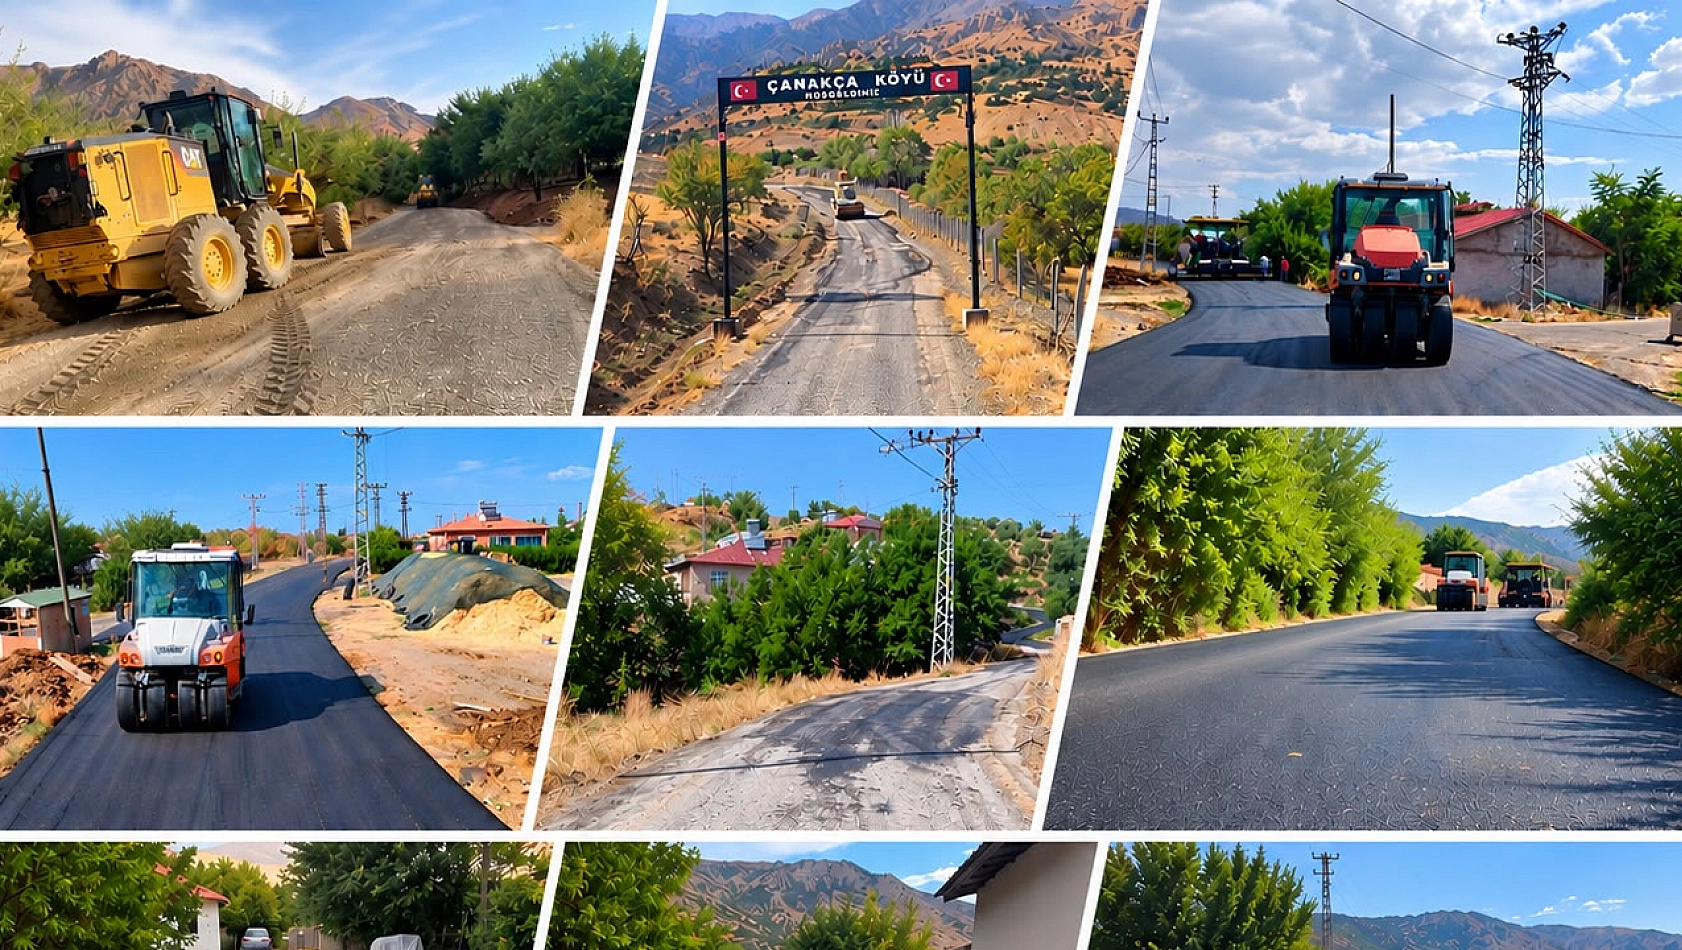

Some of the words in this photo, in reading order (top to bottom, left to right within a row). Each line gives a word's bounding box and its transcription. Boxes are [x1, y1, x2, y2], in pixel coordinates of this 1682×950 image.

[767, 76, 859, 95] ÇANAKÇA
[875, 69, 926, 87] KÖYÜ
[181, 145, 203, 169] CAT
